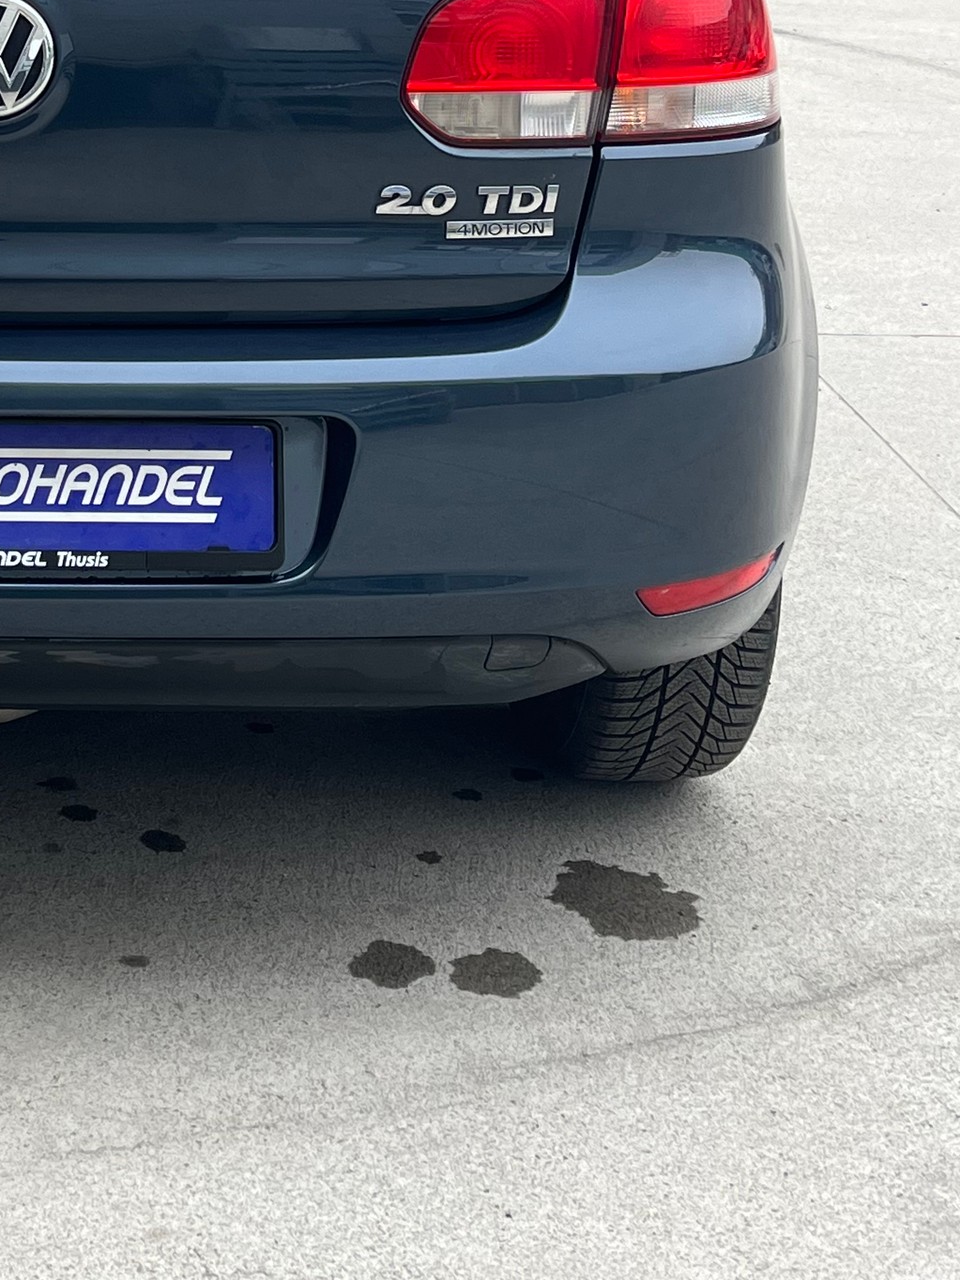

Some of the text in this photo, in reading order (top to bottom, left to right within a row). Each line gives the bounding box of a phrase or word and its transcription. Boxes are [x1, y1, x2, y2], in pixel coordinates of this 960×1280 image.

[375, 184, 560, 216] 2.0 TDI
[456, 221, 545, 237] 4MOTION
[56, 551, 109, 568] Thusis
